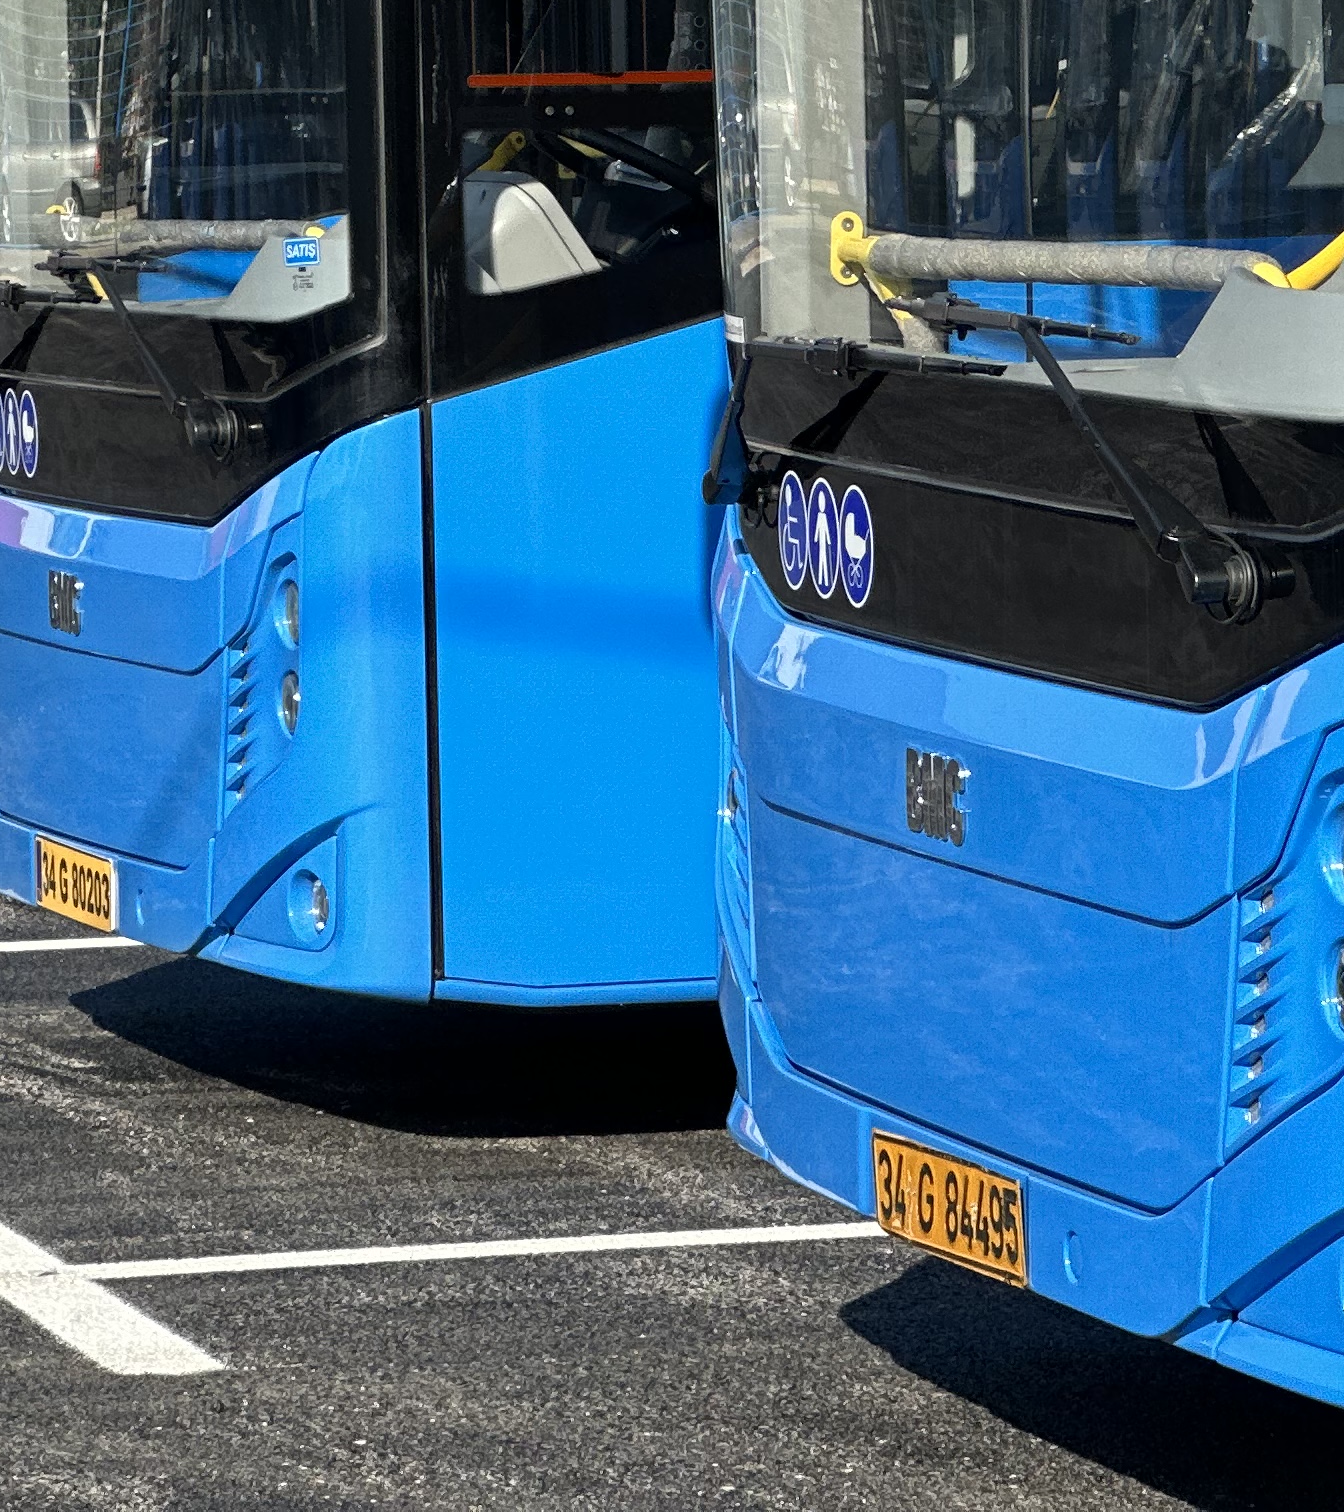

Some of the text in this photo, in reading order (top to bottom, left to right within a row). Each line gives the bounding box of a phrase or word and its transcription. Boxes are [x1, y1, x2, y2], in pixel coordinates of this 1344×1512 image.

[42, 851, 110, 919] 34 G 80203
[877, 1149, 1020, 1265] 34 G 84495
